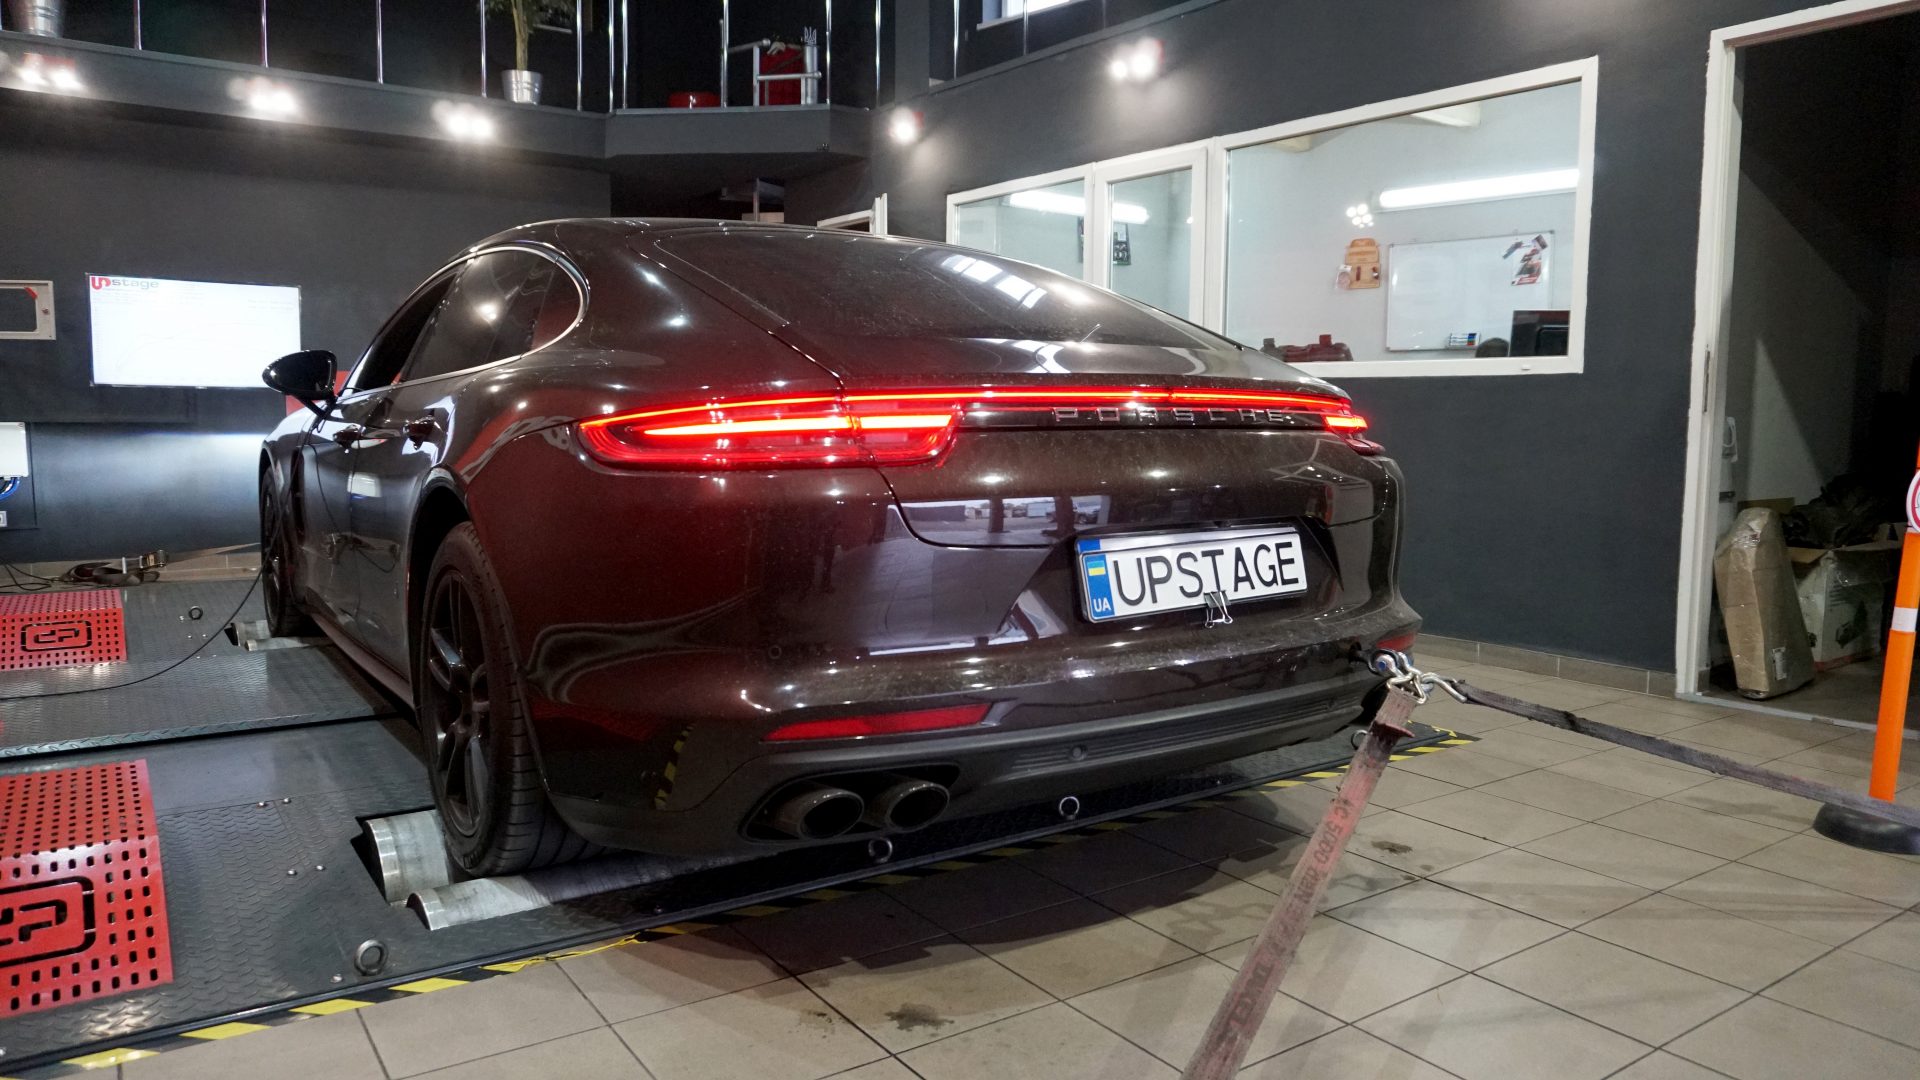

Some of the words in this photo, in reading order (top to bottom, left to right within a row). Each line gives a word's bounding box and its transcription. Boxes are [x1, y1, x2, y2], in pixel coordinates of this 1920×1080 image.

[1052, 407, 1284, 421] PORSCHE
[1113, 541, 1299, 606] UPSTAGE
[1093, 597, 1112, 613] UA
[1313, 820, 1344, 865] 5000
